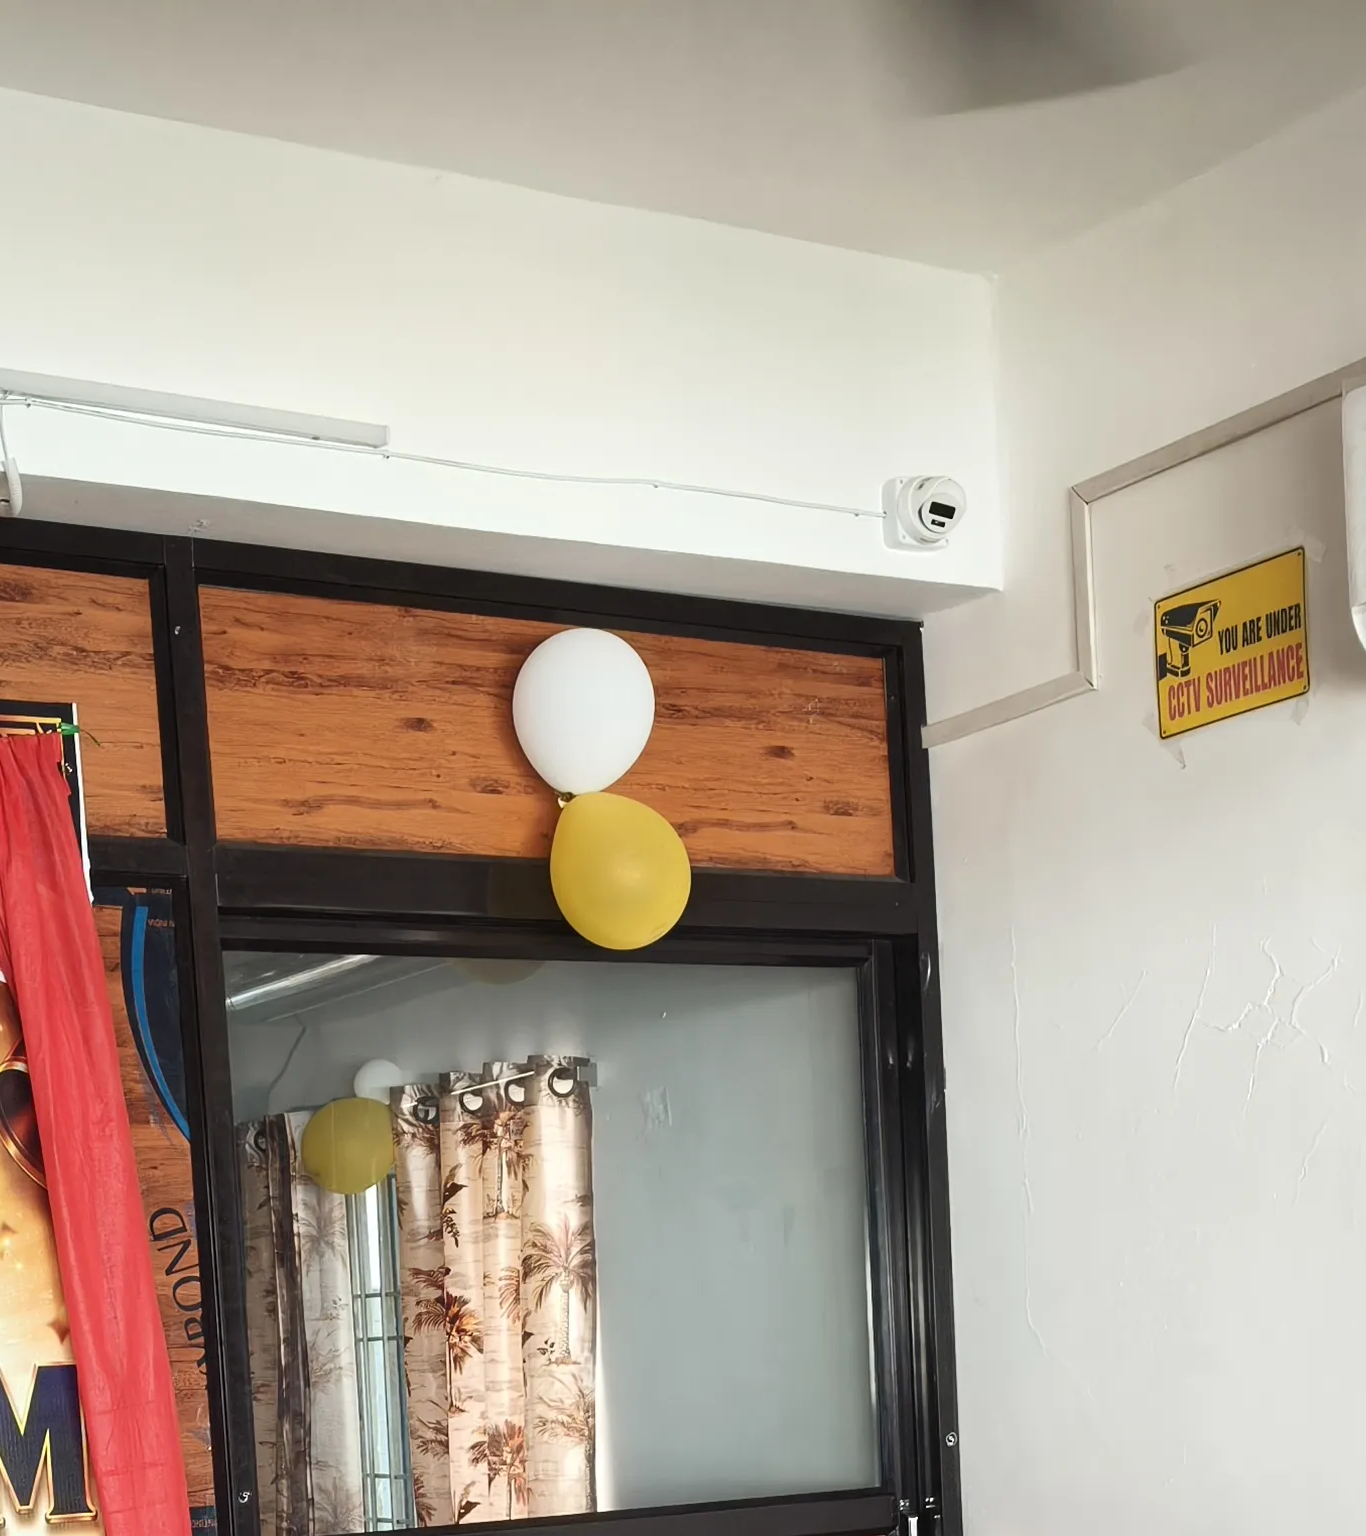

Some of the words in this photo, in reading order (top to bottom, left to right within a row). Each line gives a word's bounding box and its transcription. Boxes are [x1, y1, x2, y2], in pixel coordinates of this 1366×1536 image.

[1218, 624, 1238, 655] YOU
[1242, 616, 1262, 648] ARE
[1266, 603, 1302, 639] UNDER
[1168, 676, 1201, 721] CCTV
[1206, 642, 1304, 708] SURVEILLANCE
